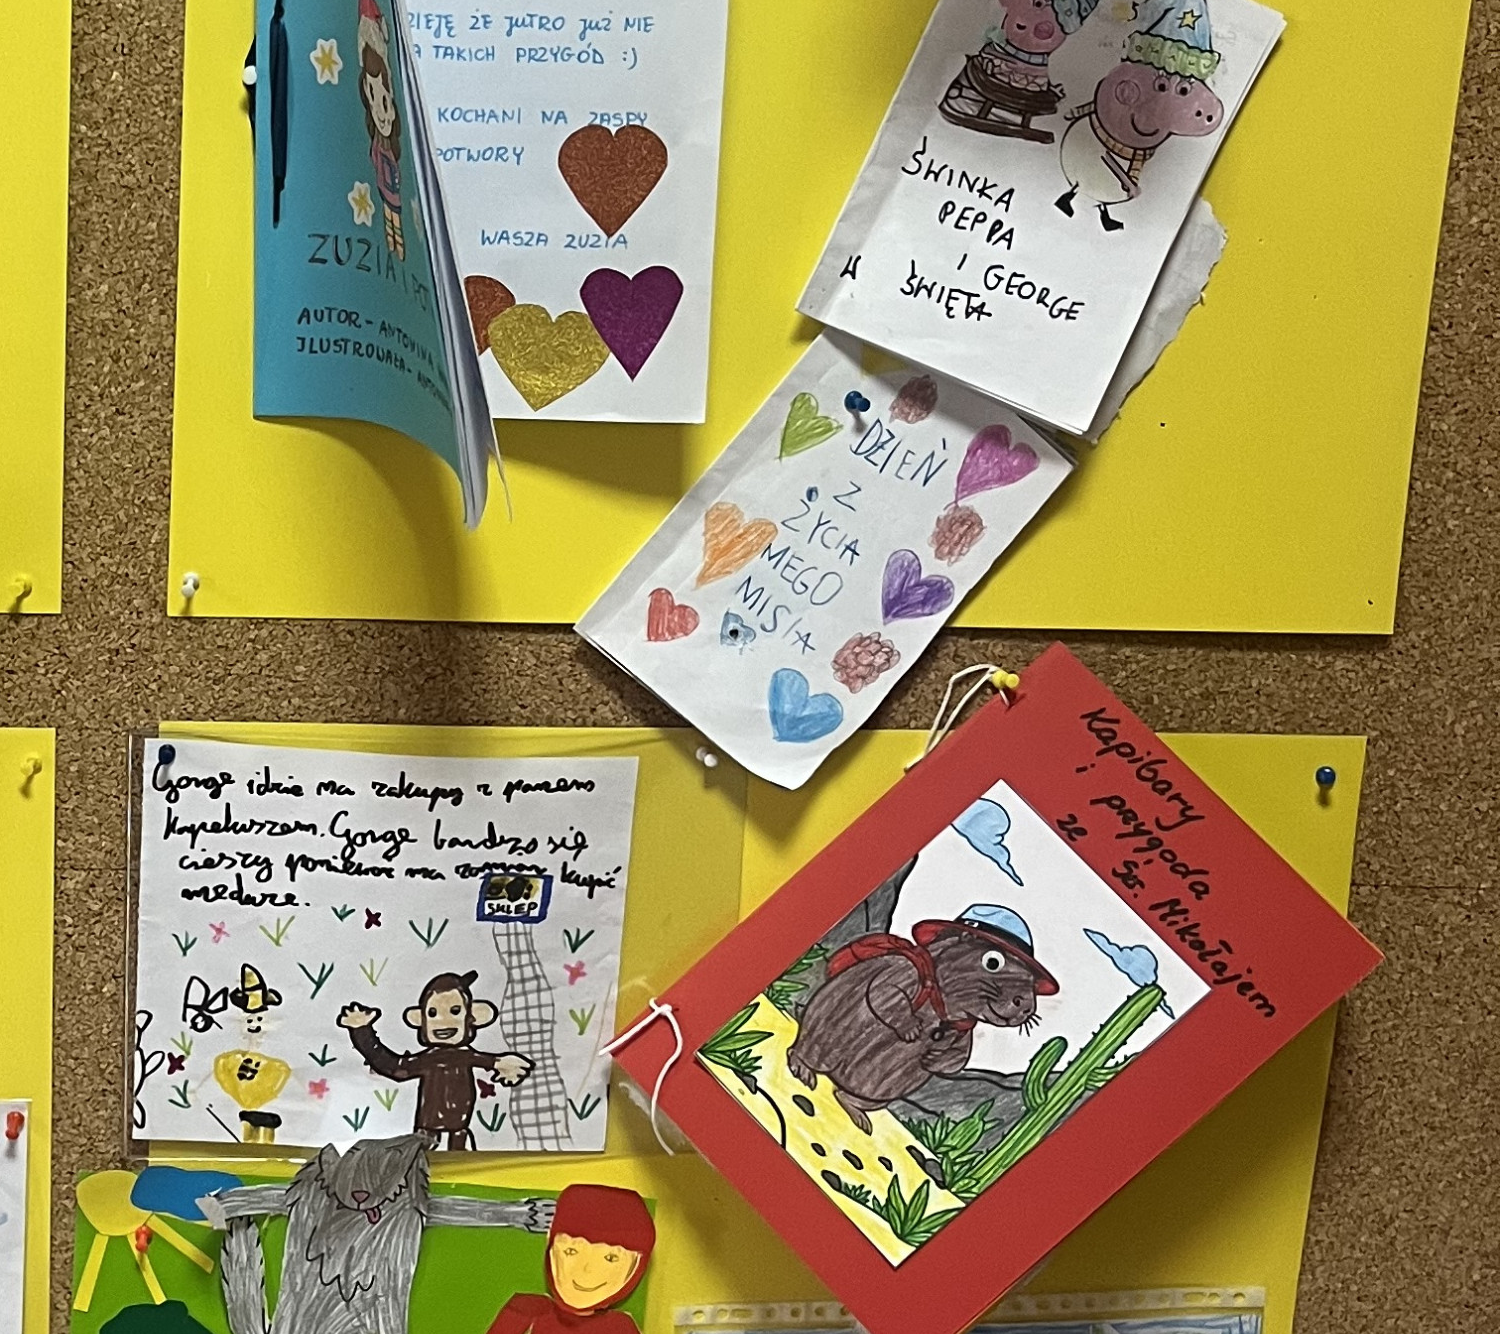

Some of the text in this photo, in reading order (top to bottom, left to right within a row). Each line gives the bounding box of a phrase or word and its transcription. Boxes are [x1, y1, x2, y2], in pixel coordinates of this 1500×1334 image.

[503, 14, 566, 38] JUTRO
[623, 16, 654, 33] NIE
[432, 45, 496, 63] TAKICH
[516, 43, 605, 64] PRZYGÓD
[437, 107, 522, 125] KOCHANI
[542, 108, 568, 124] NA
[902, 136, 1015, 212] ŚWINKA
[481, 230, 629, 250] WASZA ZUZIA
[938, 202, 1014, 249] PEPPA
[308, 234, 396, 282] ZUZIA
[298, 307, 361, 328] AUTOR
[984, 266, 1085, 321] GEORGE
[850, 418, 948, 486] DZIEŃ
[833, 481, 863, 512] Z
[760, 543, 844, 606] MEGO
[735, 576, 816, 655] MISIA
[1080, 707, 1205, 832] Kapibary
[1148, 898, 1277, 1019] Mikołajem
